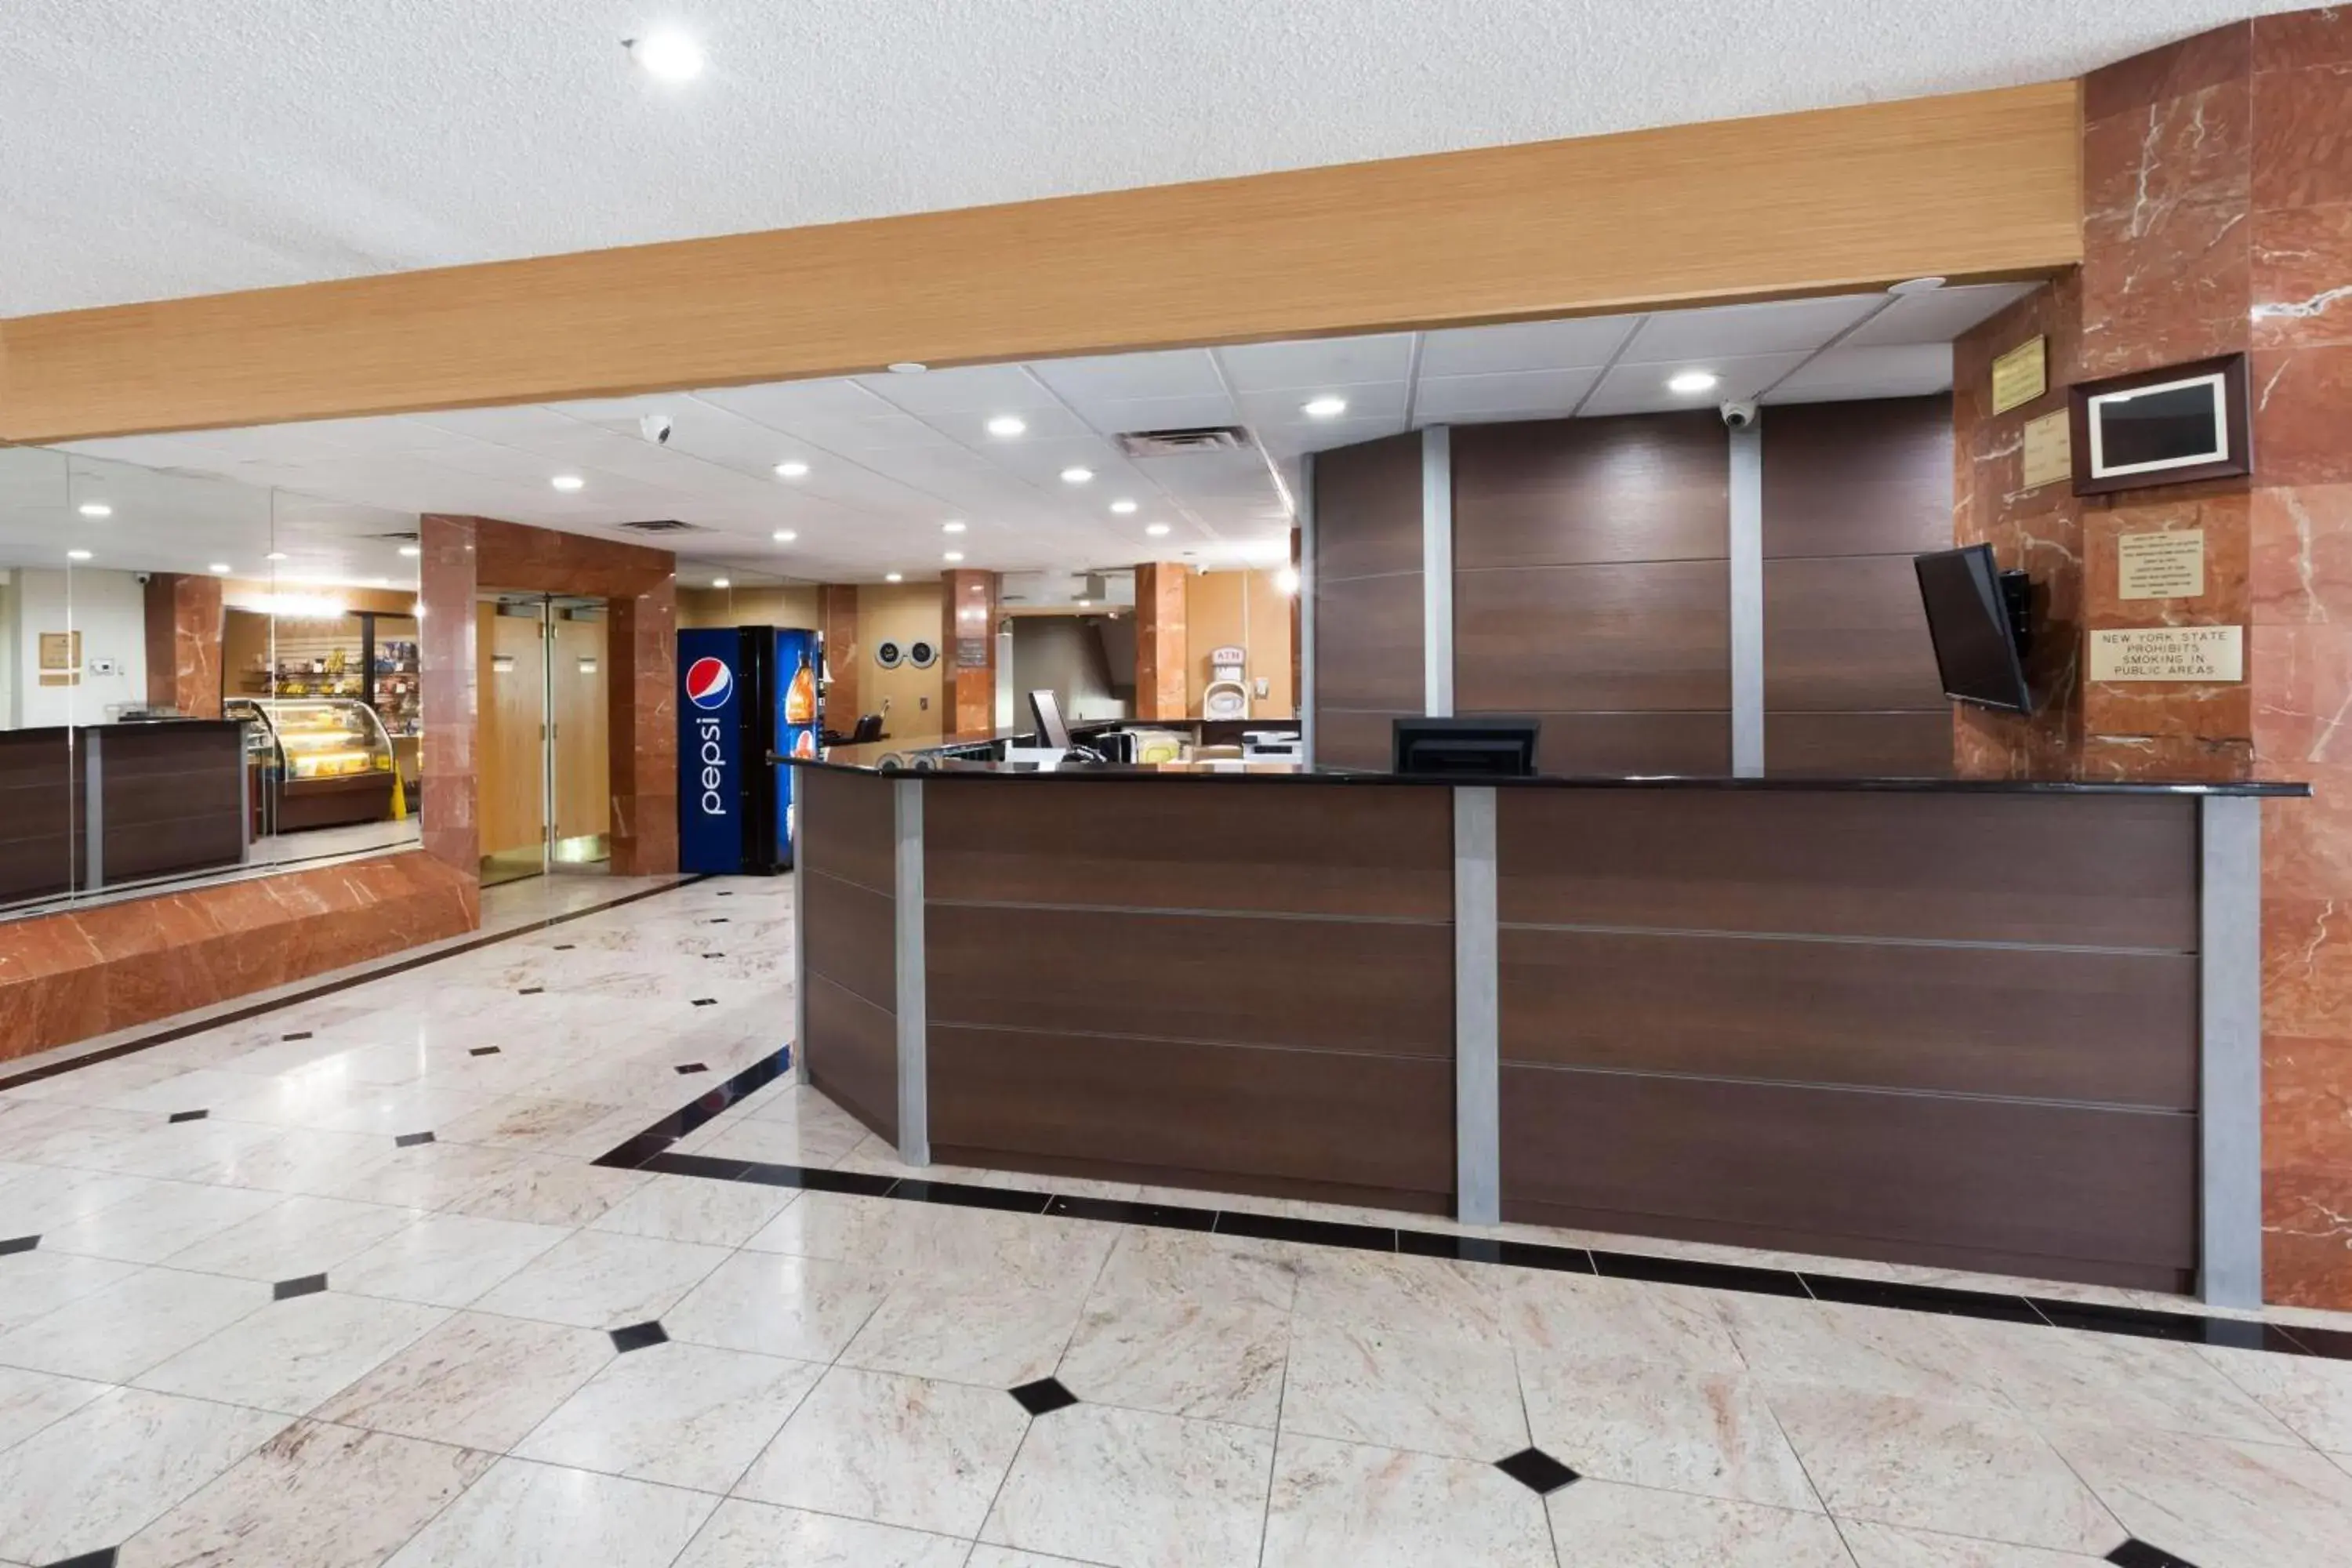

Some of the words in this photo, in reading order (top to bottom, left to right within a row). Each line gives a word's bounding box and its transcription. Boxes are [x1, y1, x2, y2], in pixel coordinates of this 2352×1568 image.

[2102, 633, 2131, 643] NEW
[2140, 633, 2175, 642] YORK
[2182, 631, 2227, 641] STATE
[2127, 644, 2200, 653] PROHIBITS
[2122, 654, 2183, 664] SMOKING
[2190, 655, 2205, 663] IN
[2114, 666, 2161, 675] PUBLIC
[2168, 665, 2215, 674] AREAS
[695, 717, 727, 815] pepsi
